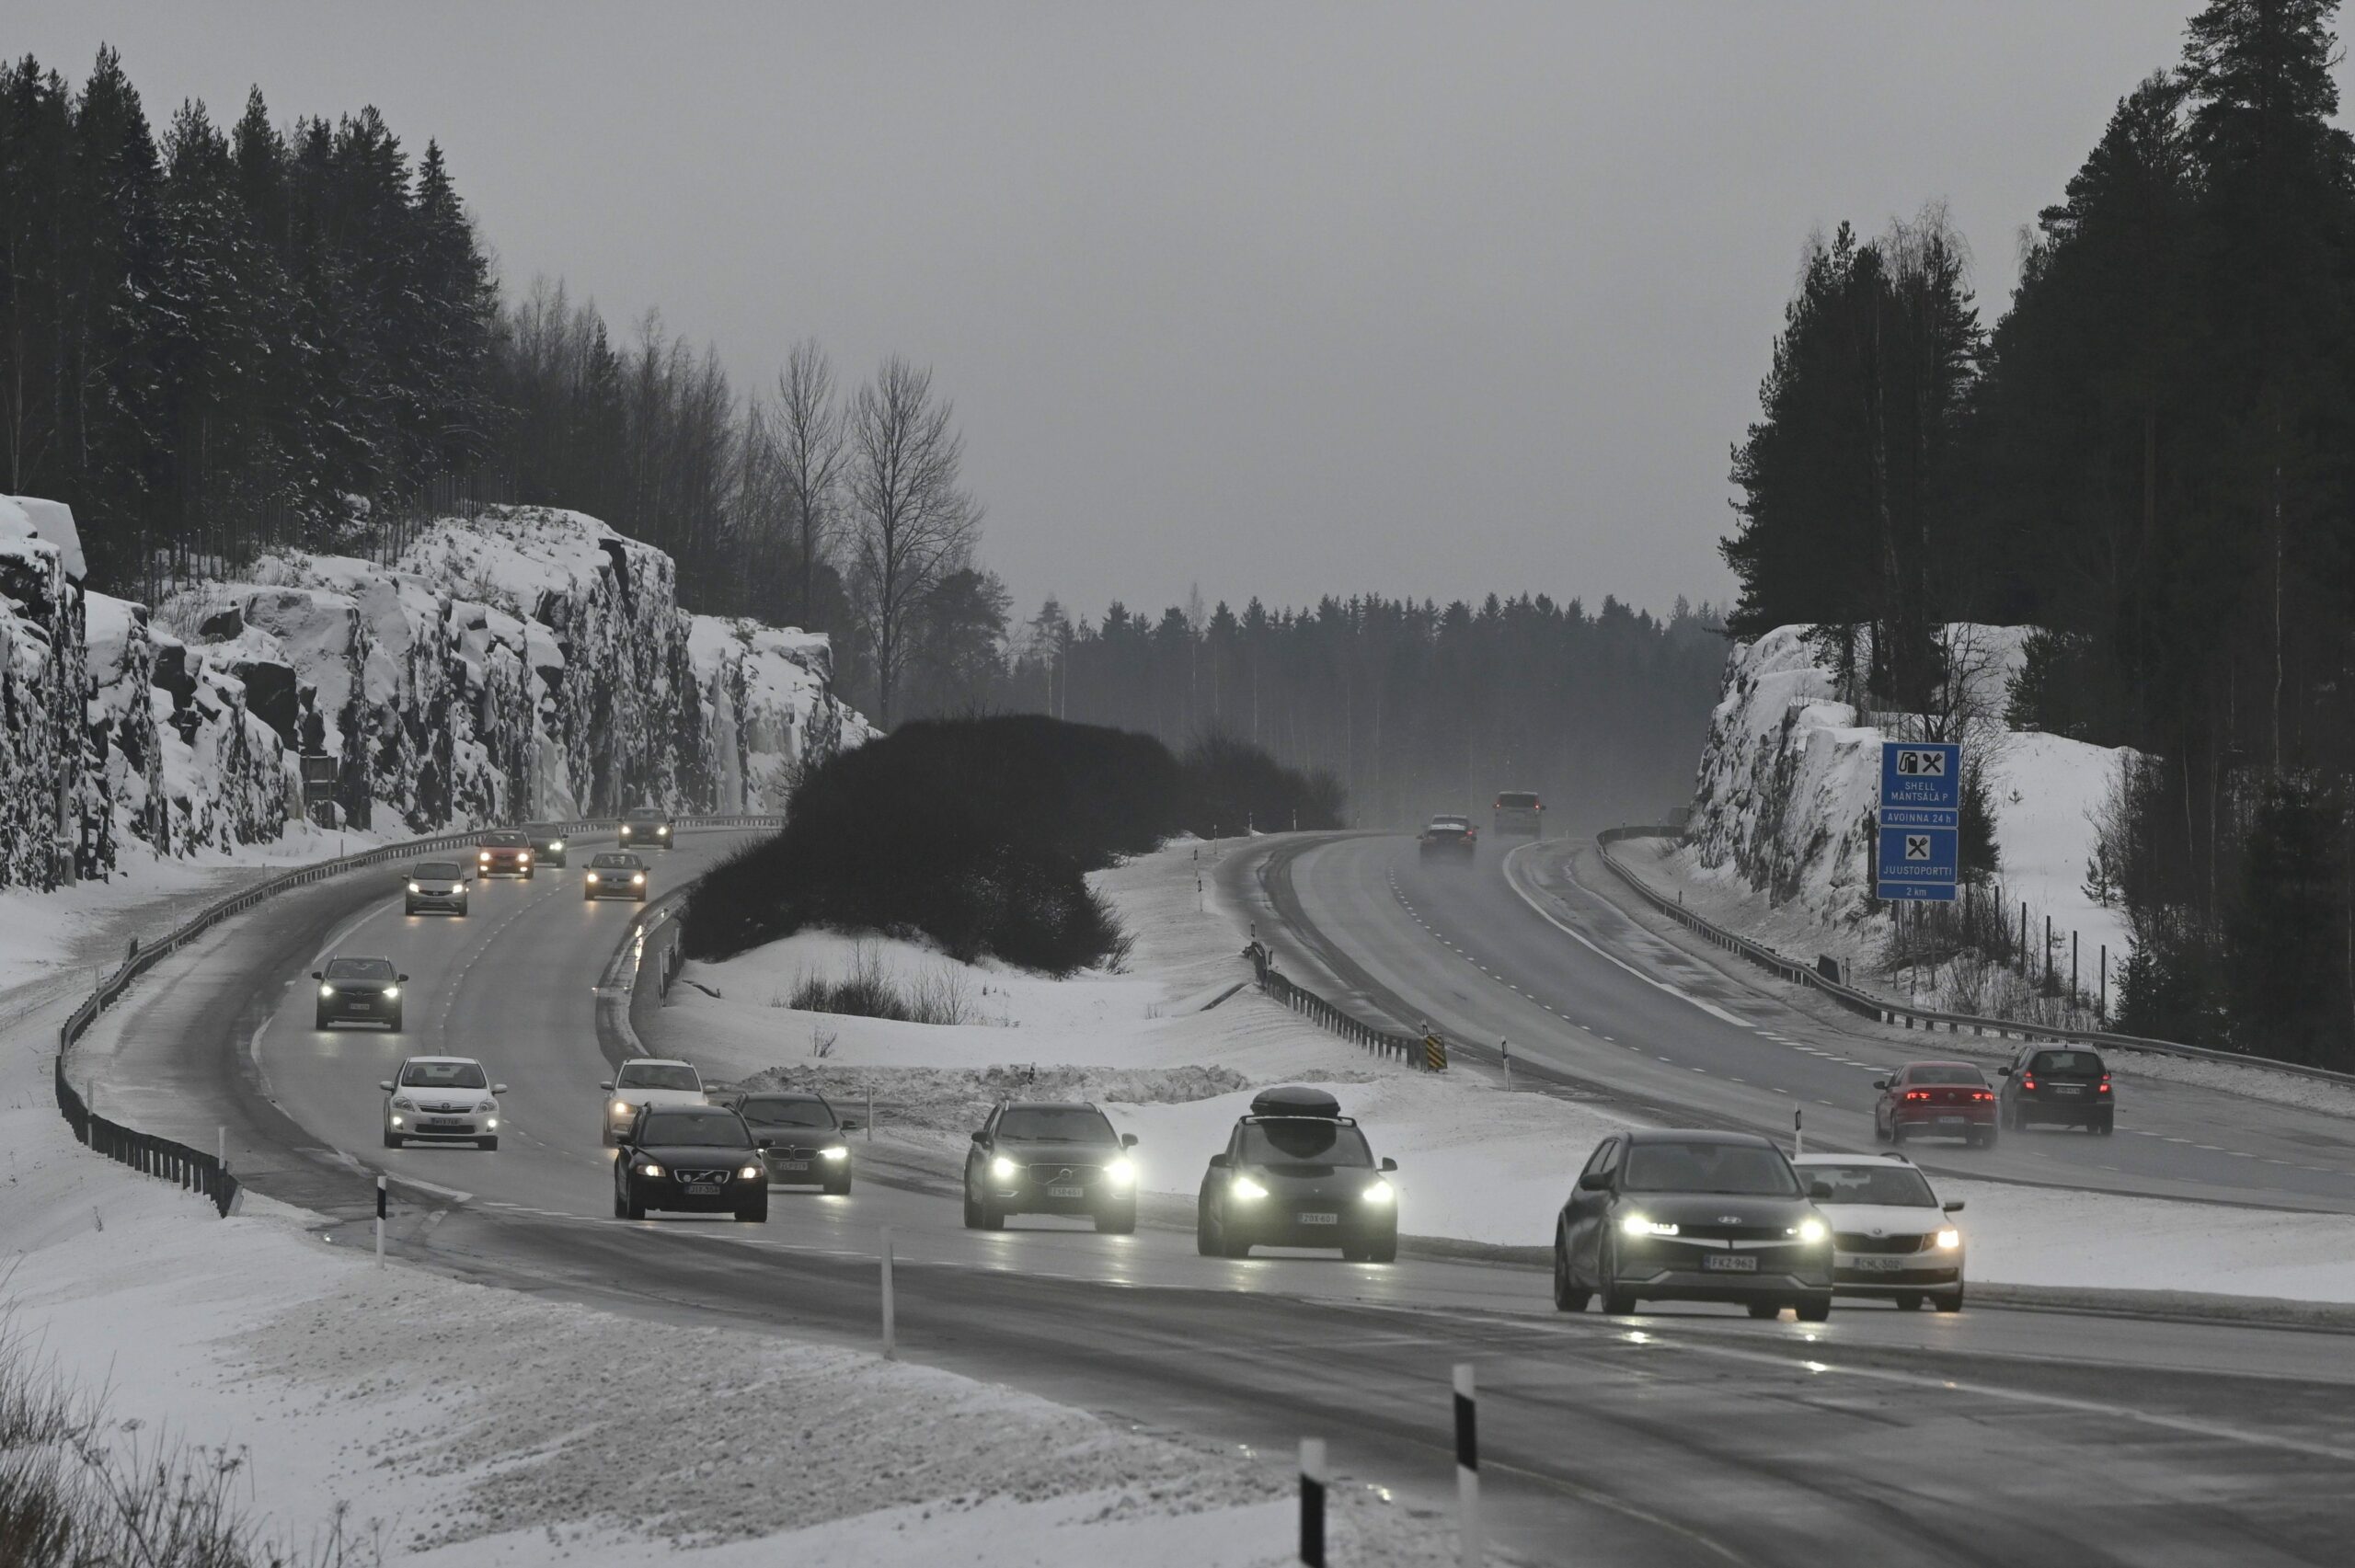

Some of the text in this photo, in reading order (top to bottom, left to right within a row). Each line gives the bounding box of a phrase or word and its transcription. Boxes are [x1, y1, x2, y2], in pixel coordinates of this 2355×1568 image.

[1905, 782, 1936, 791] SHELL
[1891, 791, 1948, 801] MÄNTSÄLÄ P
[1888, 813, 1951, 823] AVOINNA 24 h
[1883, 866, 1952, 876] JUUSTOPORTTI
[1906, 887, 1927, 897] 2 km
